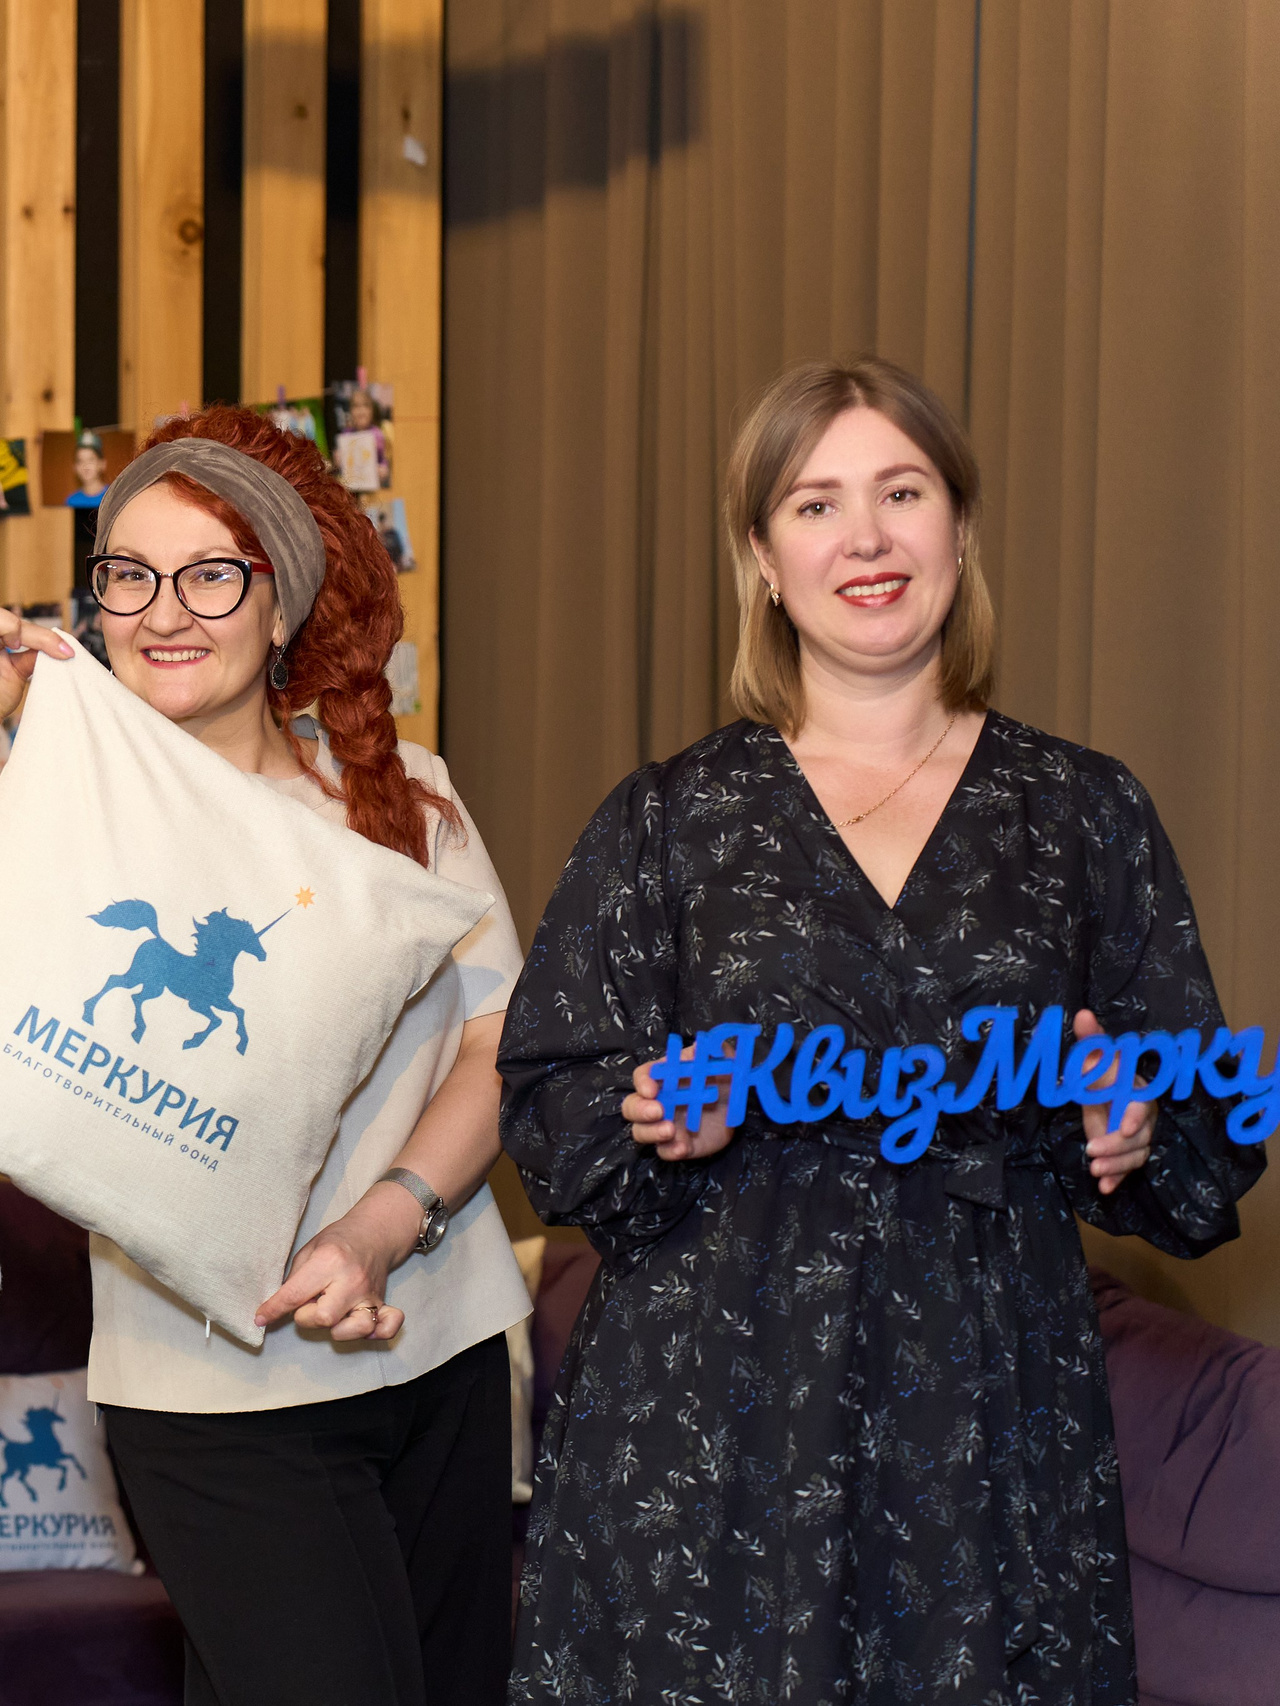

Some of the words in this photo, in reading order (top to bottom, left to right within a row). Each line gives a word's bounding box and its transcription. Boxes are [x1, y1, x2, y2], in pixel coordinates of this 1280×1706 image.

[3, 1043, 175, 1146] БЛАГОТВОРИТЕЛЬНЫЙ
[180, 1144, 219, 1173] ФОНД
[13, 1004, 240, 1152] МЕРКУРИЯ
